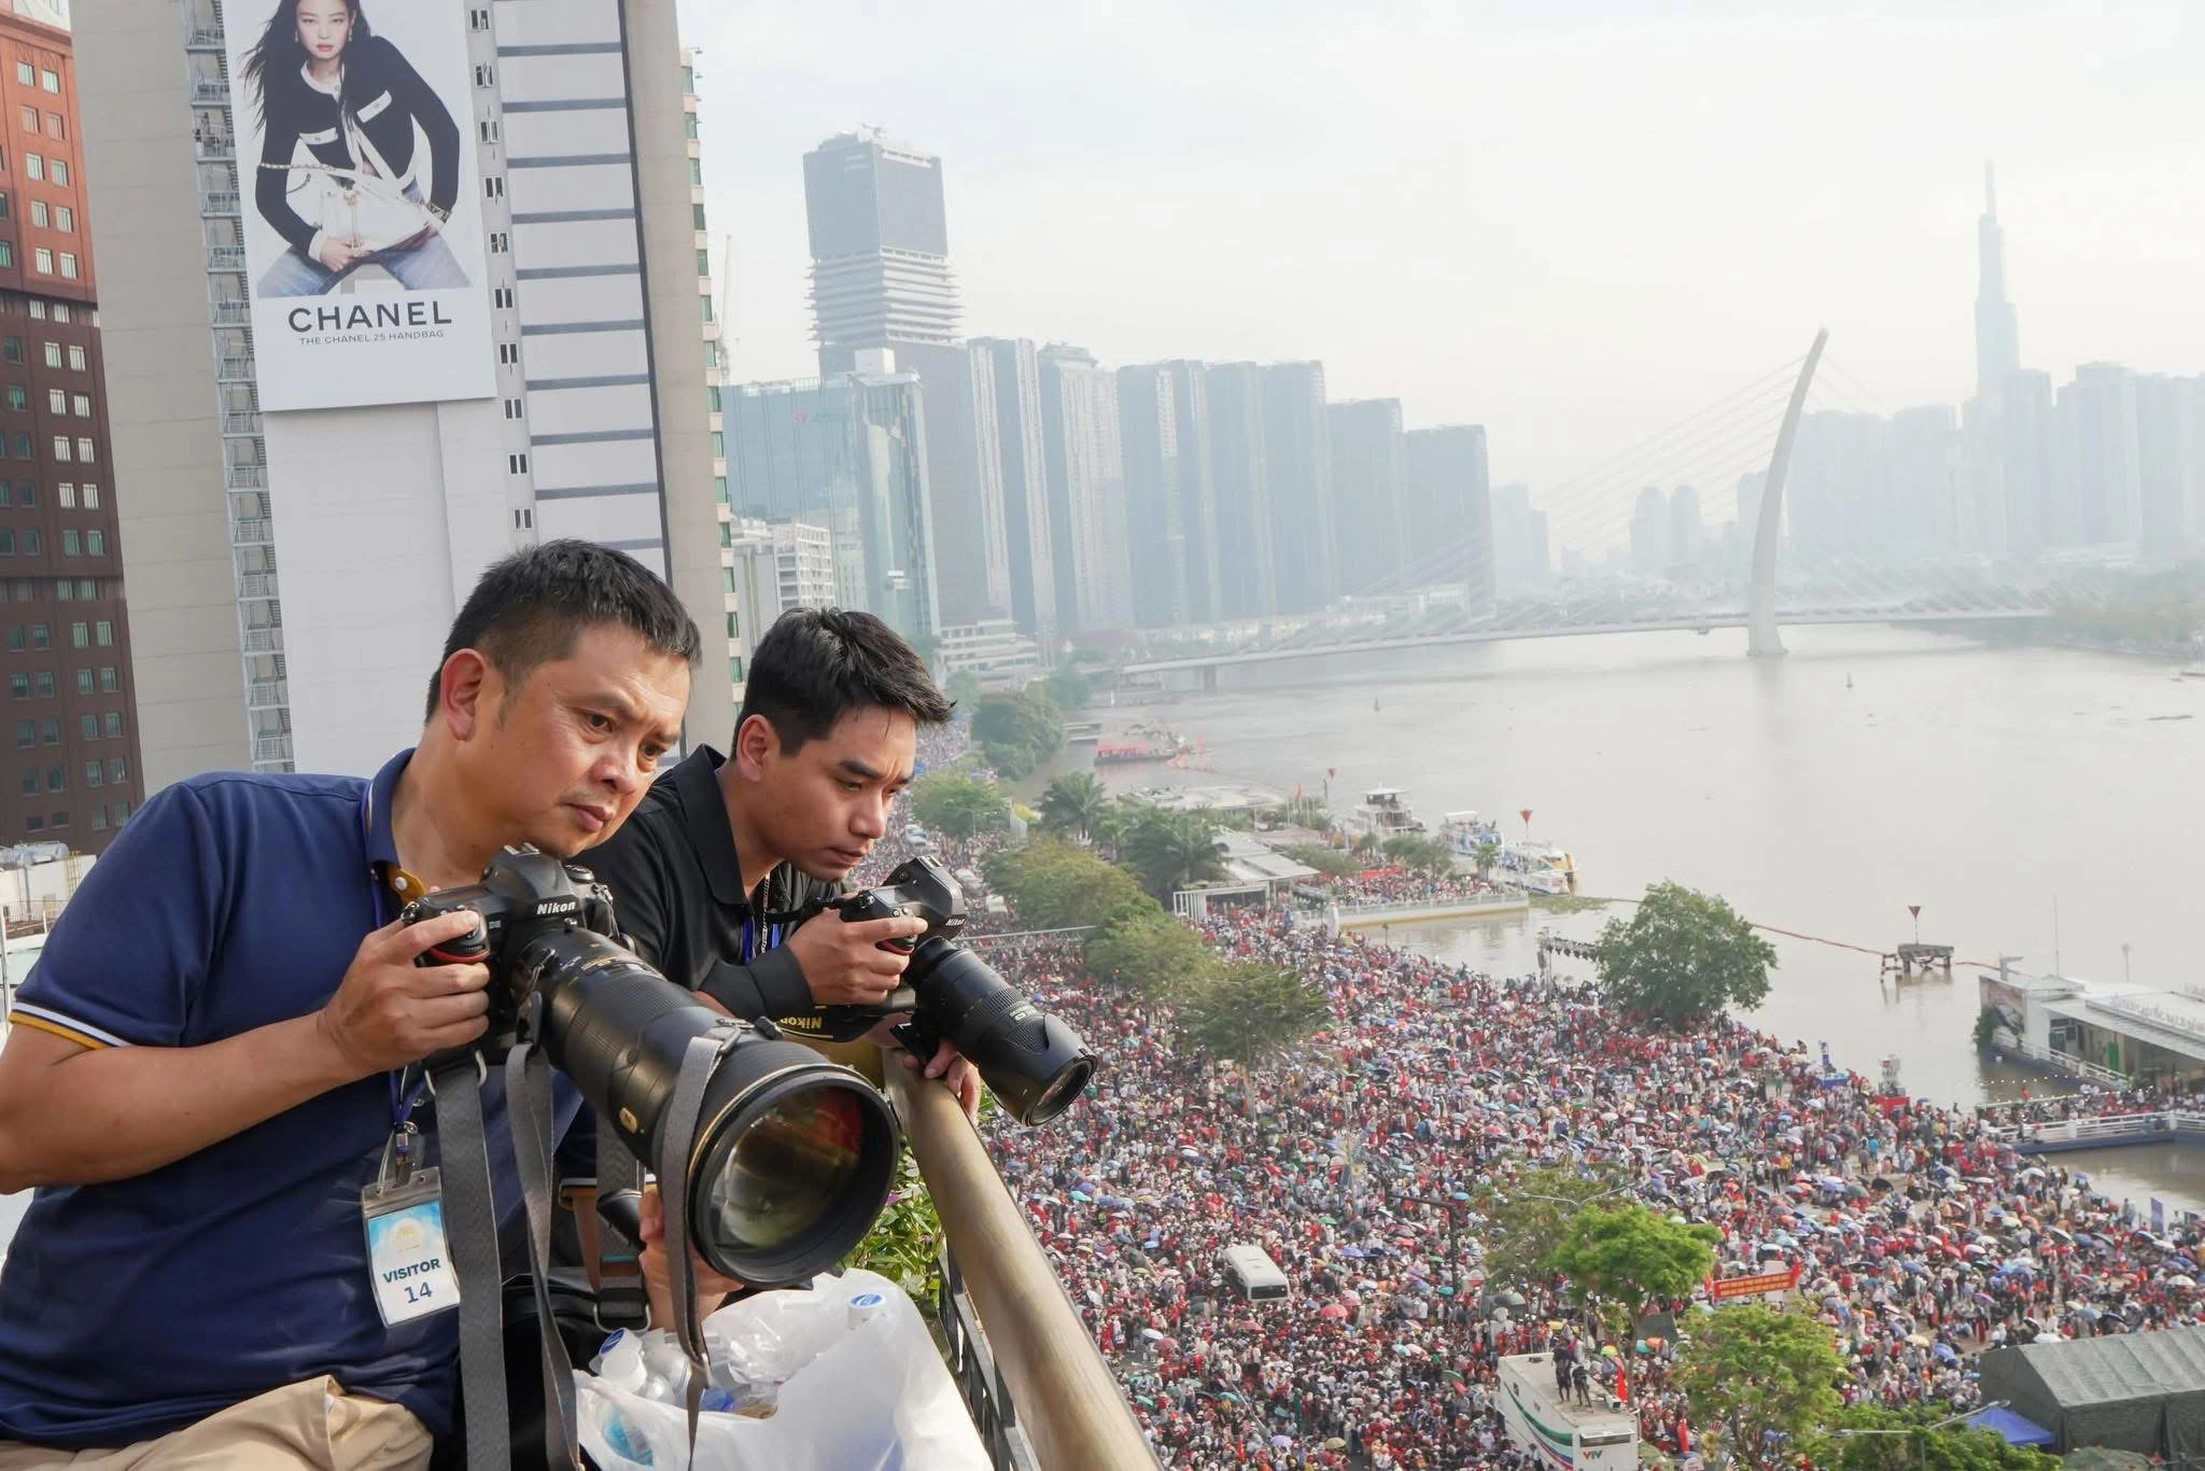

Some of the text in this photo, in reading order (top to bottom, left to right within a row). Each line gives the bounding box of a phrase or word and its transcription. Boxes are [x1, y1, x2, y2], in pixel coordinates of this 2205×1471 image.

[288, 301, 452, 332] CHANEL
[300, 330, 445, 346] THE CHANEL 25 HANDBAG
[536, 901, 576, 915] Nikon
[382, 1258, 441, 1284] VISITOR
[404, 1281, 433, 1304] 14
[1582, 1450, 1603, 1461] VTV
